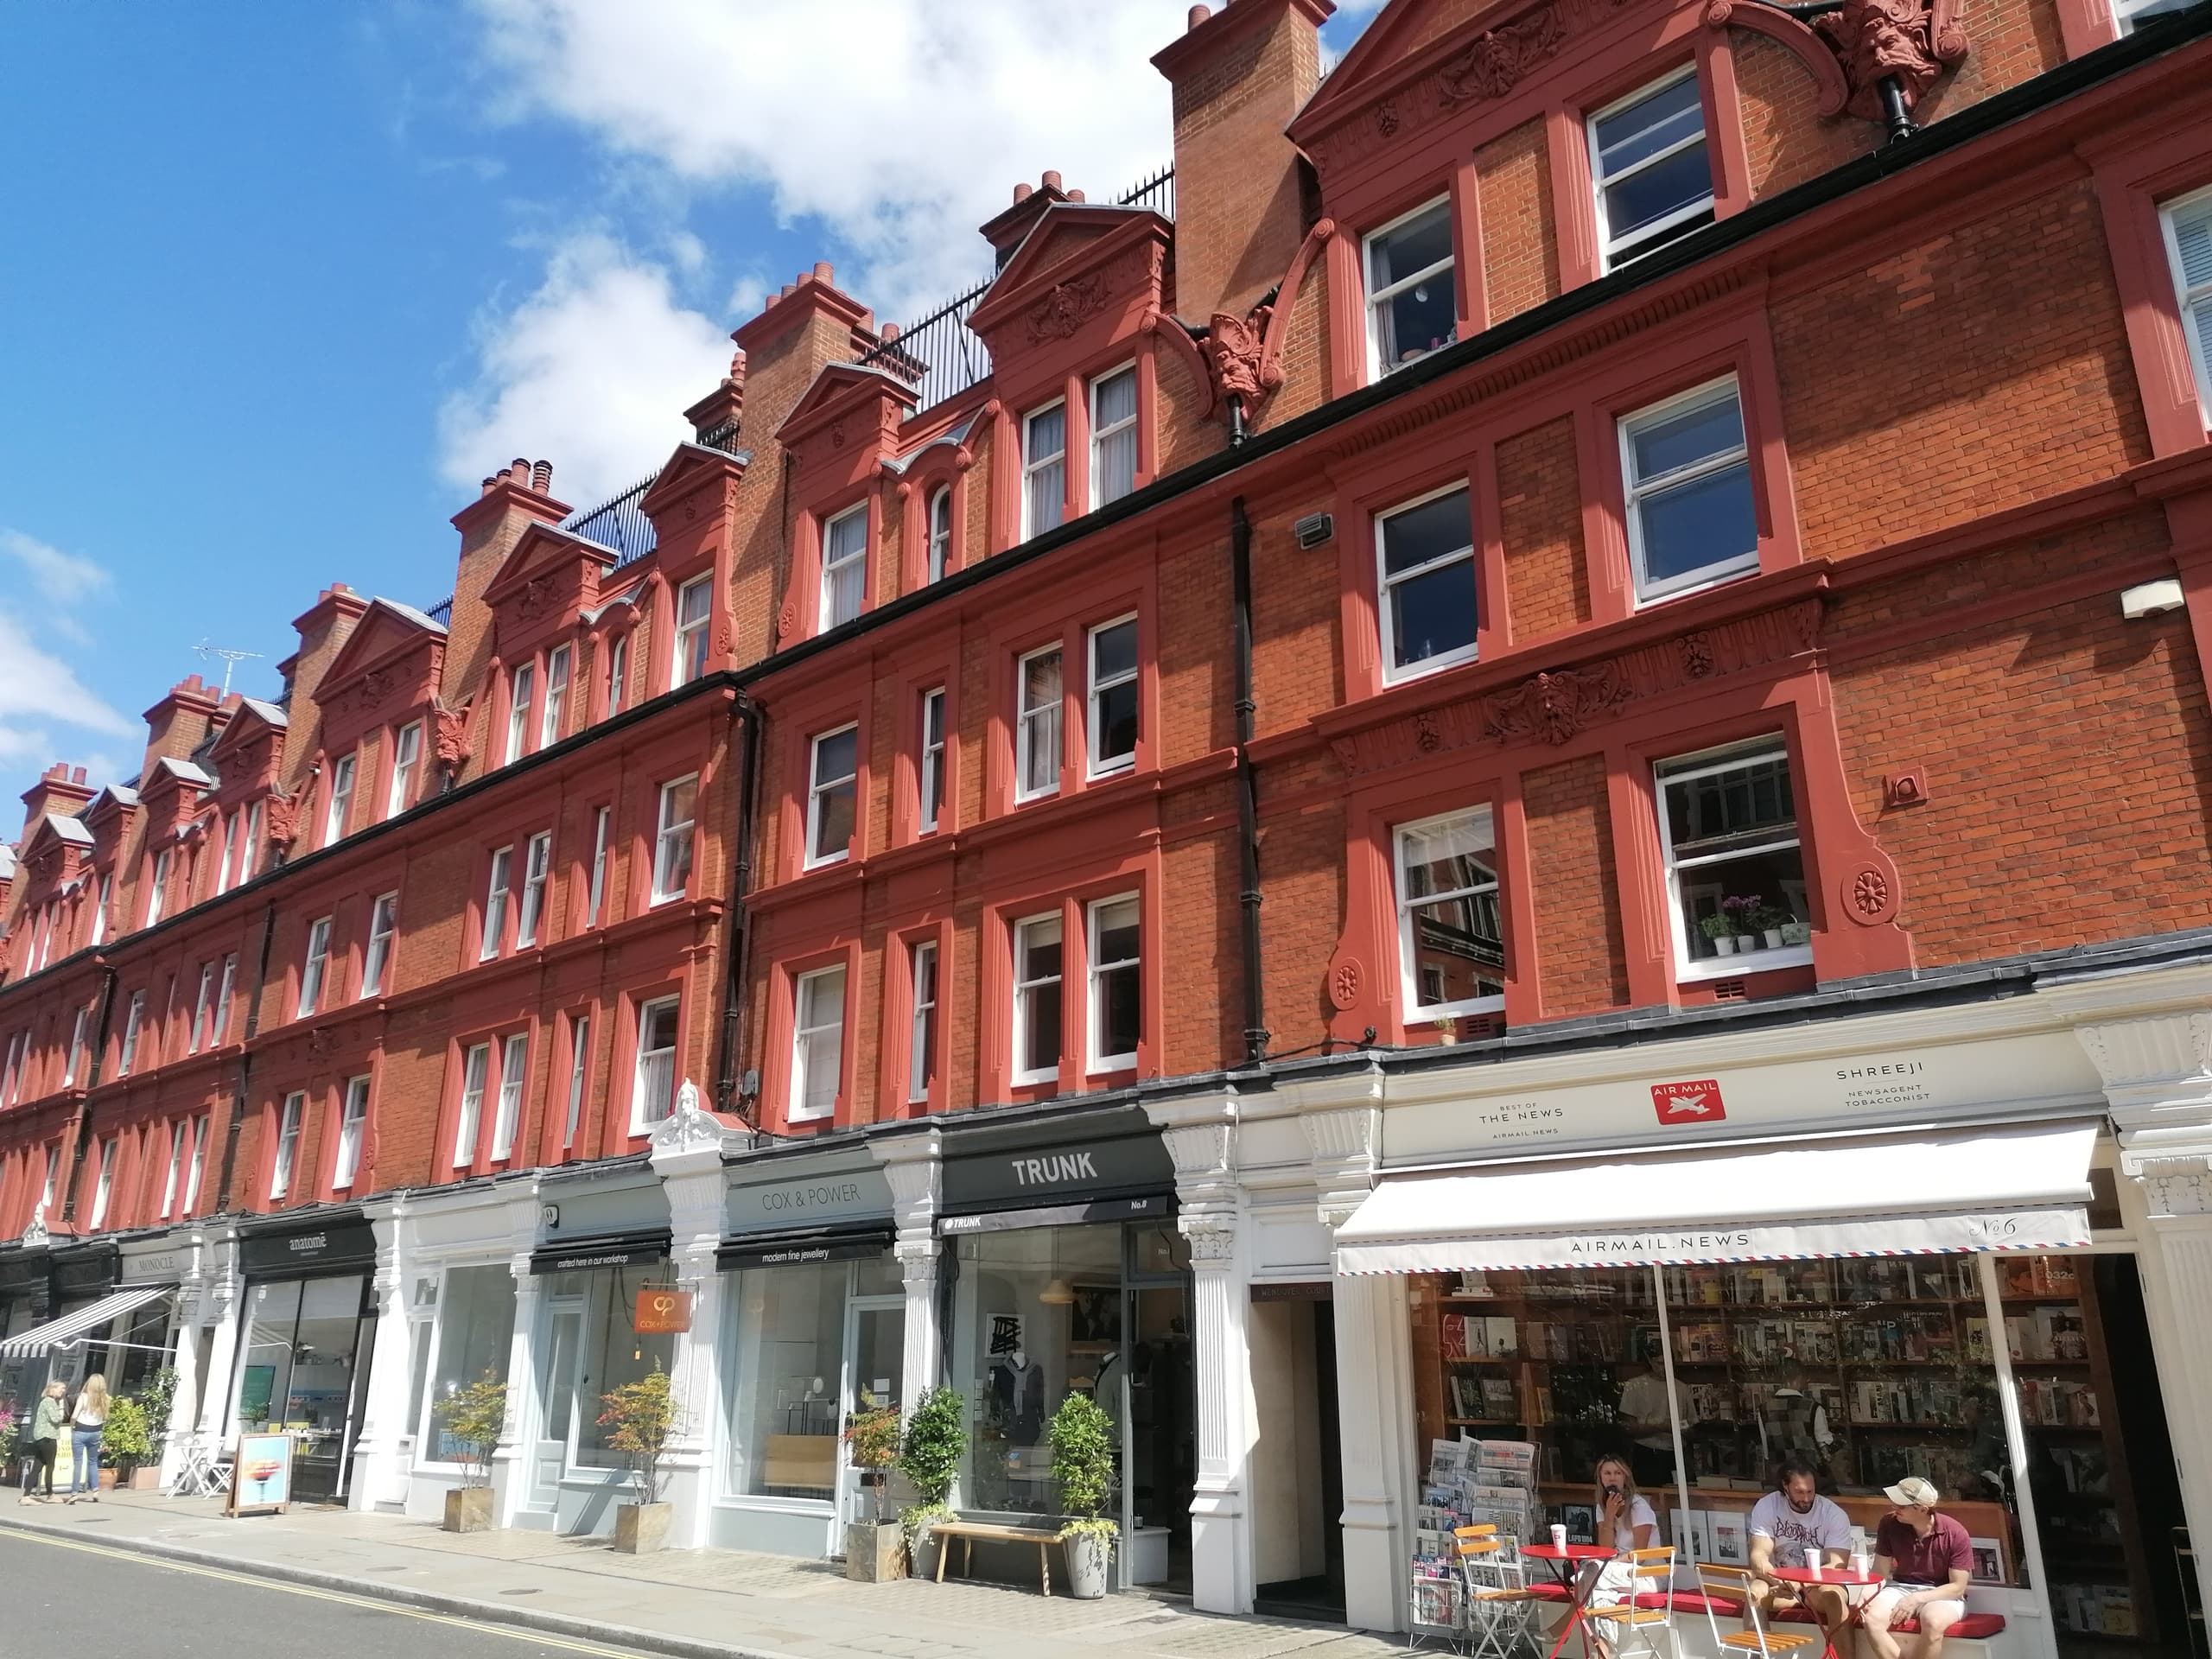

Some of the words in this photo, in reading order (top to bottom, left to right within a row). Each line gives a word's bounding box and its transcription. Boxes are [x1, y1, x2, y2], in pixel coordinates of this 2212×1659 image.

[1836, 1062, 1923, 1080] SHREEJI
[1654, 1086, 1677, 1096] AIR
[1681, 1083, 1717, 1093] MAIL
[1848, 1084, 1922, 1097] NEWSAGENT
[1845, 1093, 1929, 1107] TOBACCONIST
[1479, 1113, 1510, 1124] THE
[1518, 1108, 1563, 1120] NEWS
[1011, 1152, 1098, 1185] TRUNK
[762, 1192, 792, 1211] COX
[796, 1191, 806, 1207] &
[808, 1184, 861, 1205] POWER
[953, 1216, 982, 1229] TRUNK
[2004, 1217, 2018, 1235] 6
[1571, 1234, 1749, 1253] AIRMAIL.NEWS
[557, 1257, 575, 1268] crafted
[575, 1258, 588, 1267] here
[603, 1253, 629, 1264] workshop
[762, 1251, 787, 1262] modern
[787, 1249, 800, 1261] fine
[800, 1247, 830, 1262] jewellery
[139, 1256, 175, 1273] MONOCLE
